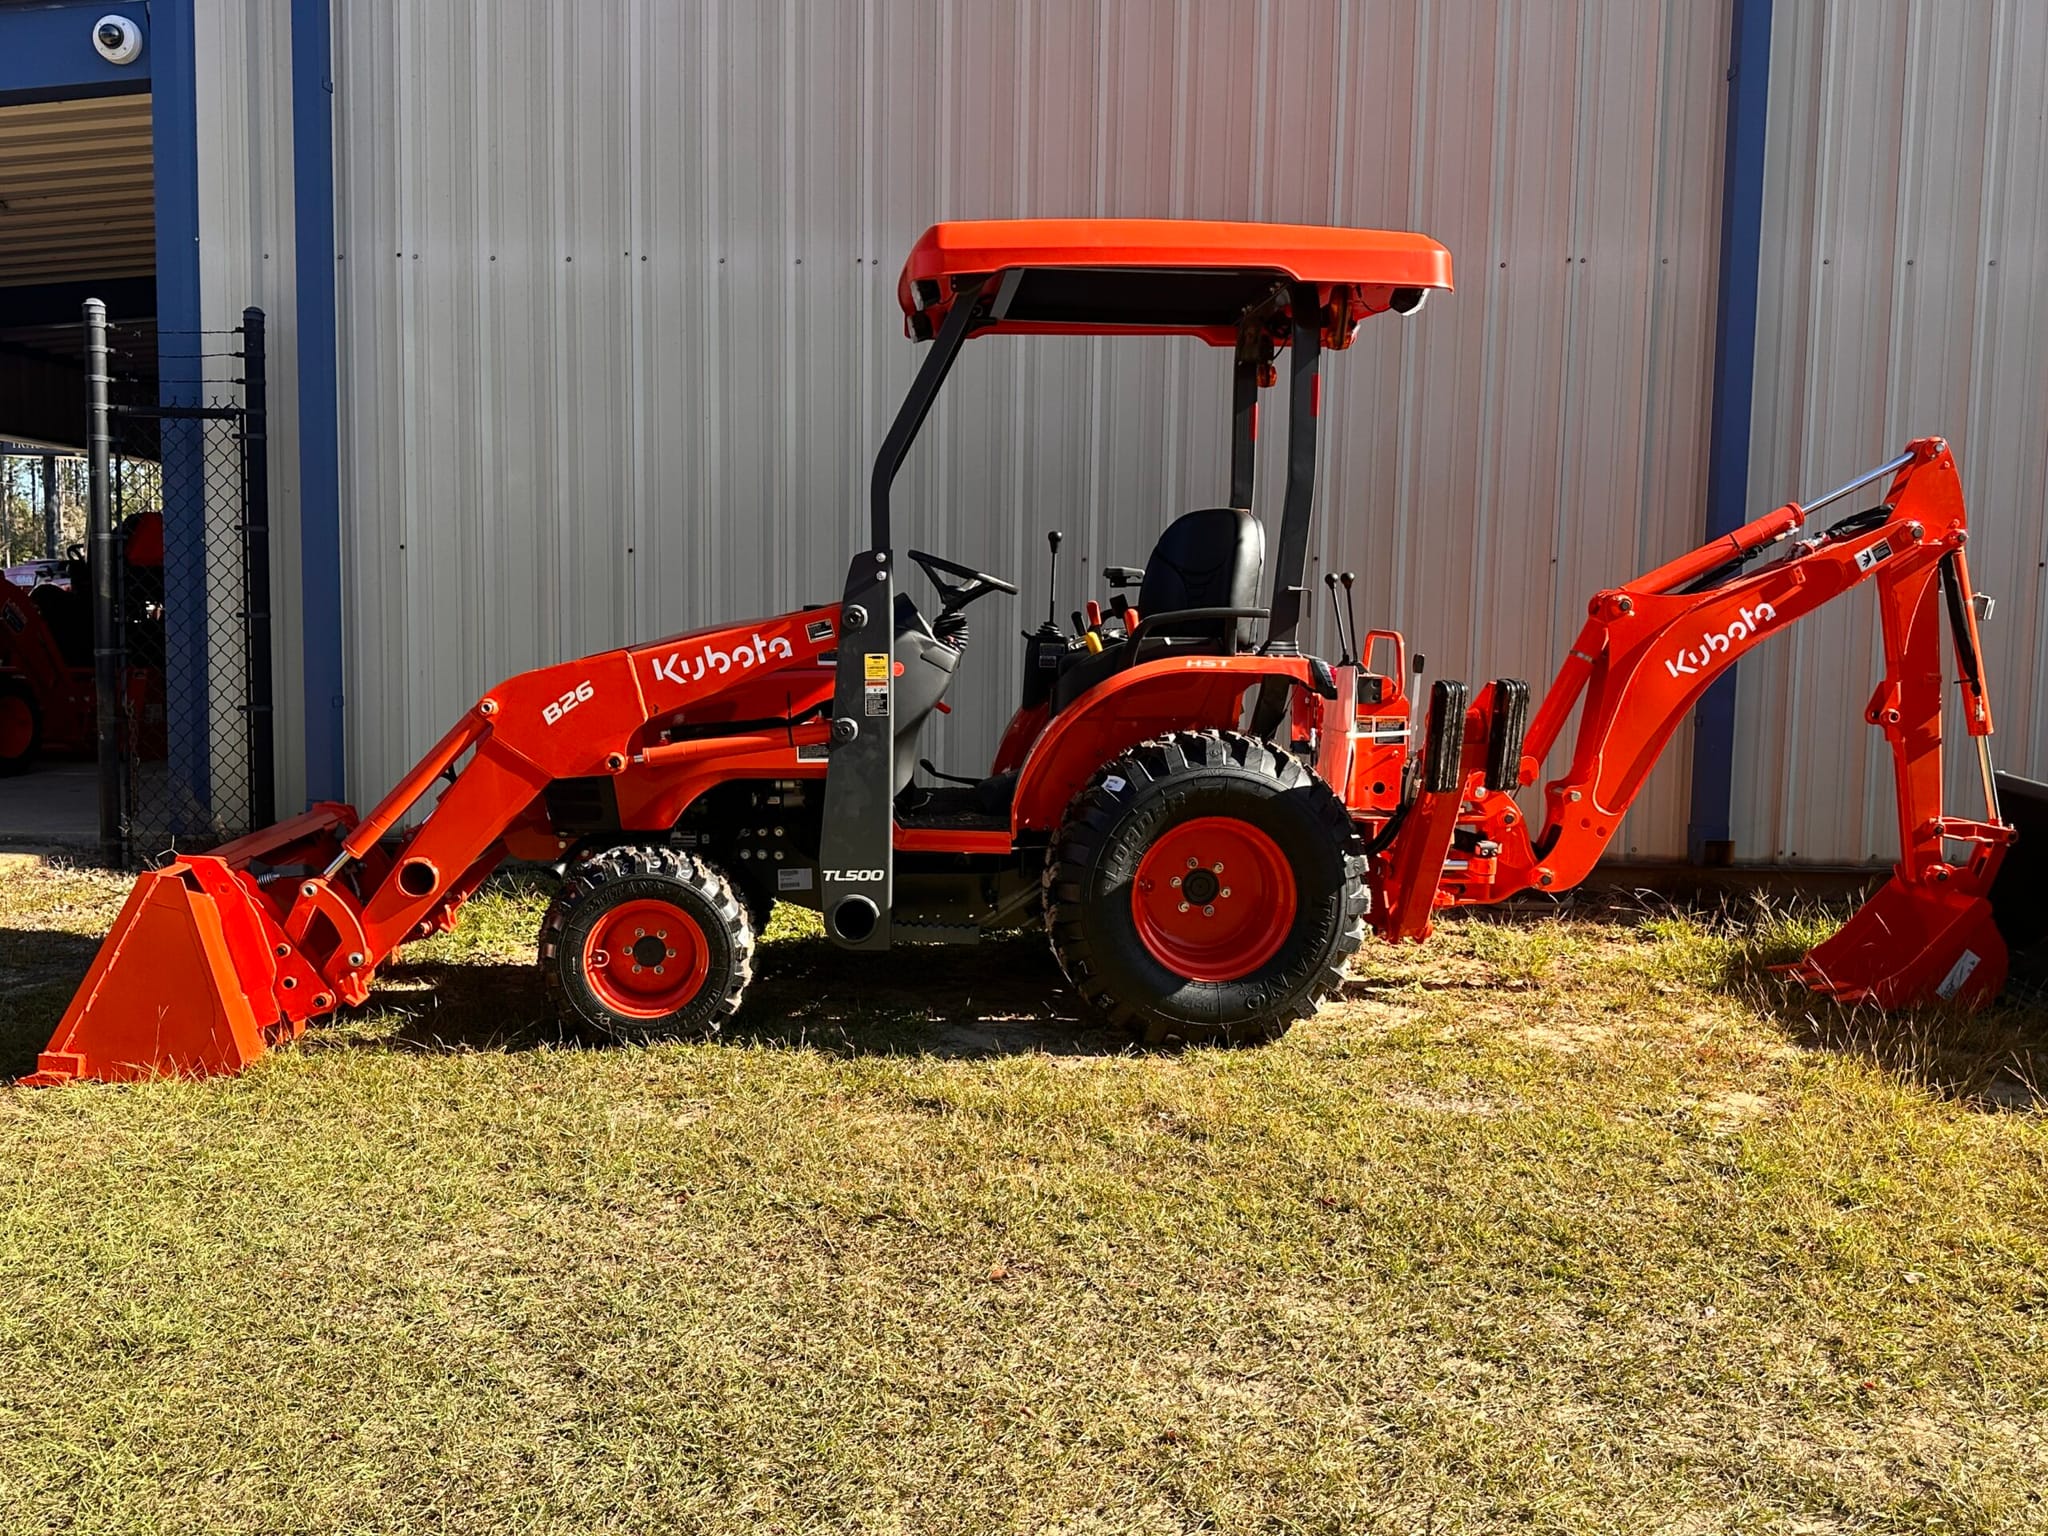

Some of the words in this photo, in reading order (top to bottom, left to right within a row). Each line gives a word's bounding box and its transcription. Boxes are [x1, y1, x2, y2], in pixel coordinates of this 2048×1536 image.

[650, 633, 793, 685] Kubota
[1185, 658, 1232, 668] HST
[1663, 602, 1777, 679] Kubota
[541, 679, 595, 726] B26
[822, 869, 885, 882] TL500
